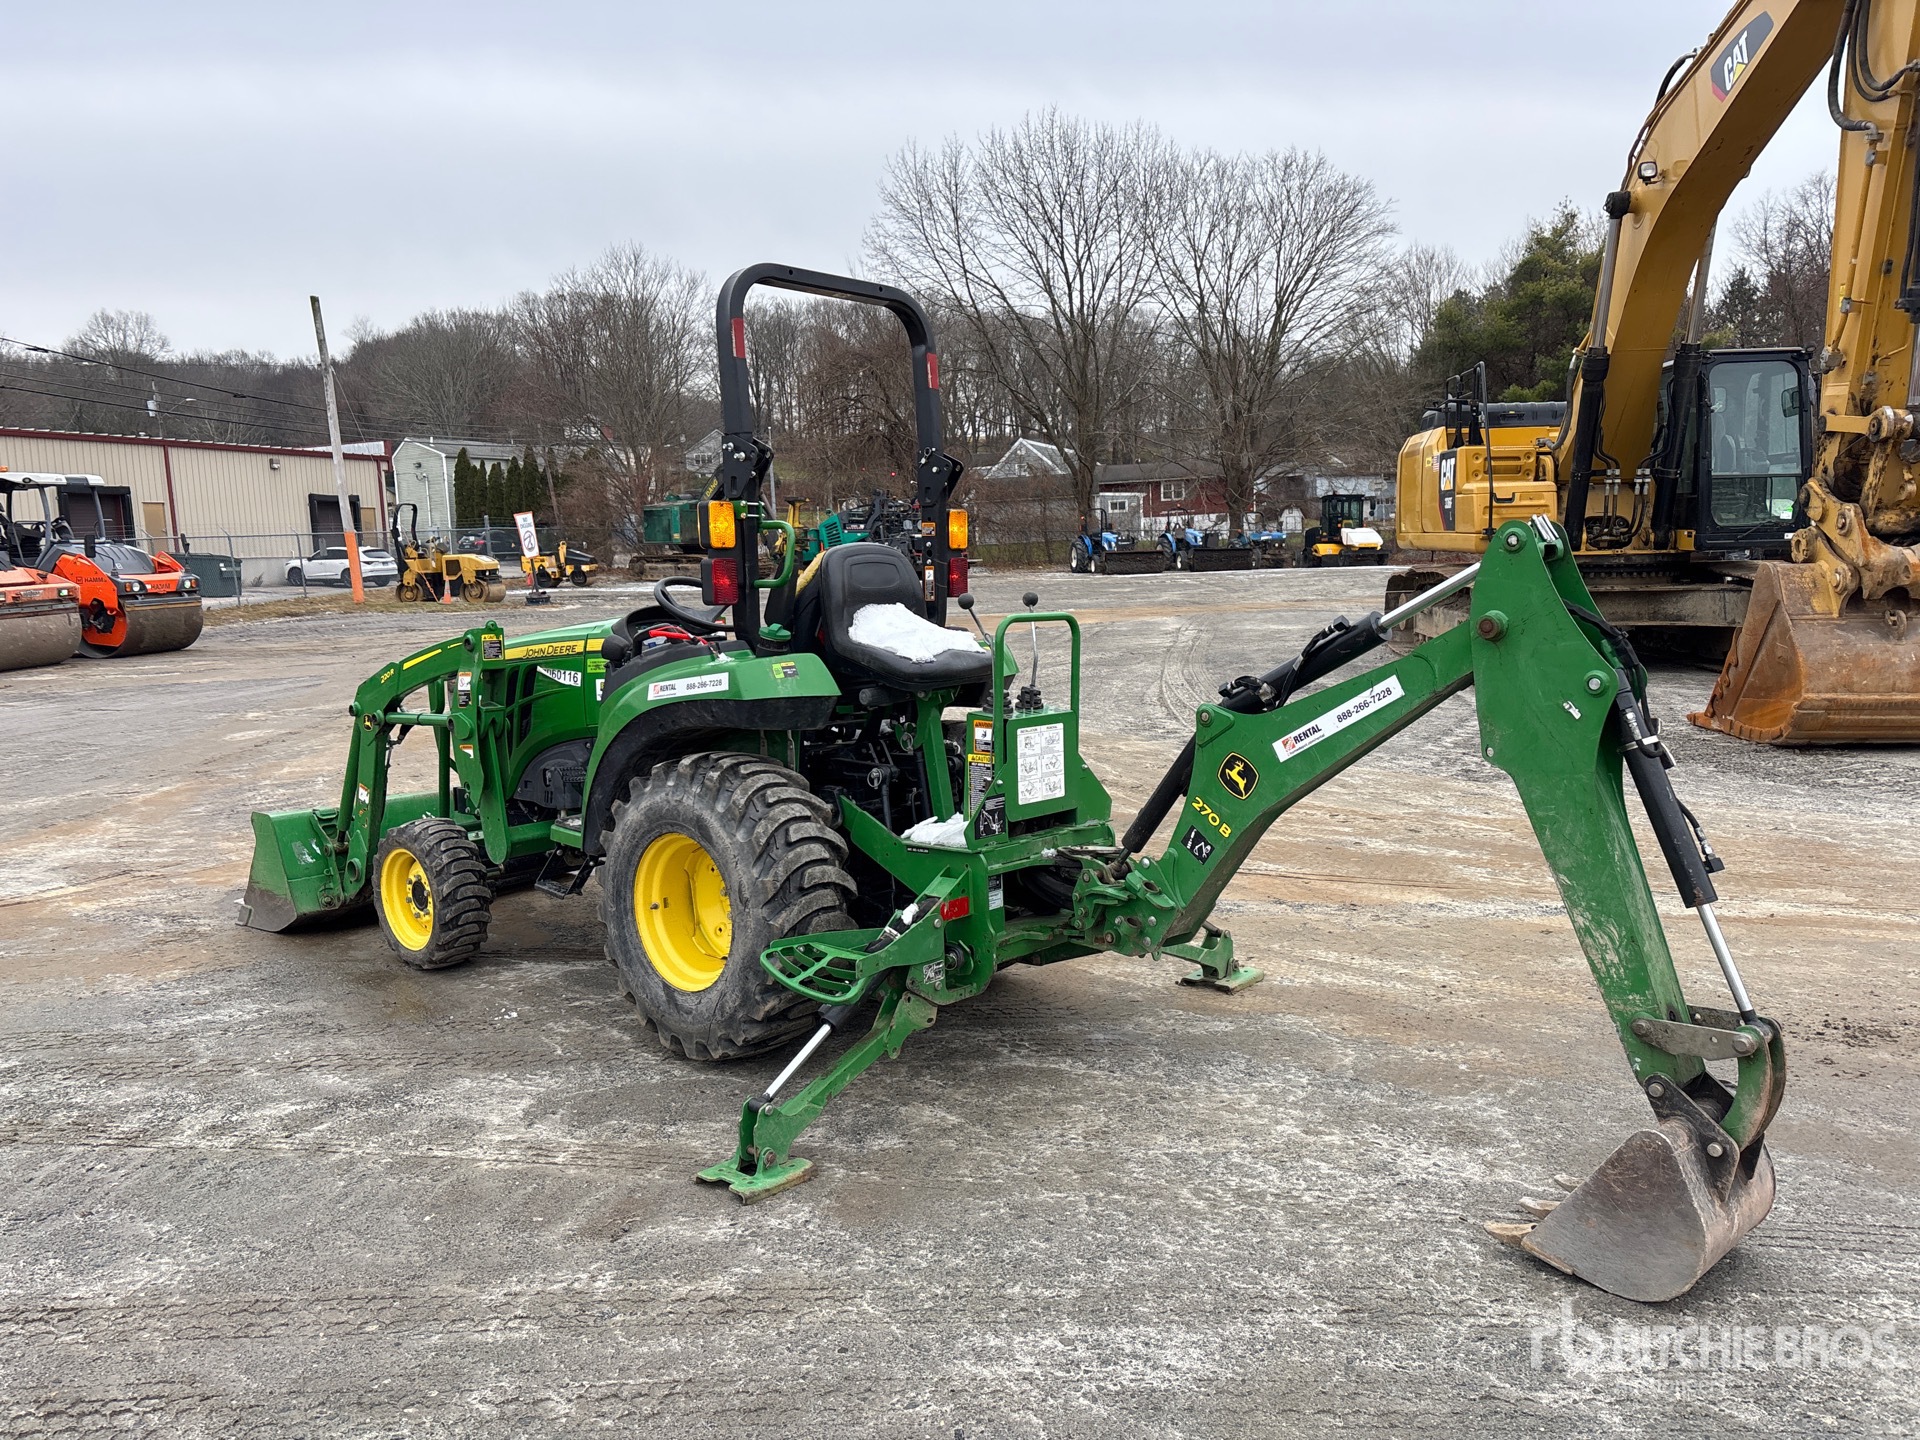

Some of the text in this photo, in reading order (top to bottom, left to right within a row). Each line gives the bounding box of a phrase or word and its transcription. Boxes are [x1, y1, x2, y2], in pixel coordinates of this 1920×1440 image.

[1724, 30, 1749, 91] CAT
[1441, 457, 1455, 491] CAT
[523, 644, 578, 658] JOHN DEERE
[660, 683, 677, 692] RENTAL
[686, 679, 723, 691] 888-266-7228
[1293, 724, 1322, 744] RENTAL
[1336, 687, 1393, 723] 888-266-7228
